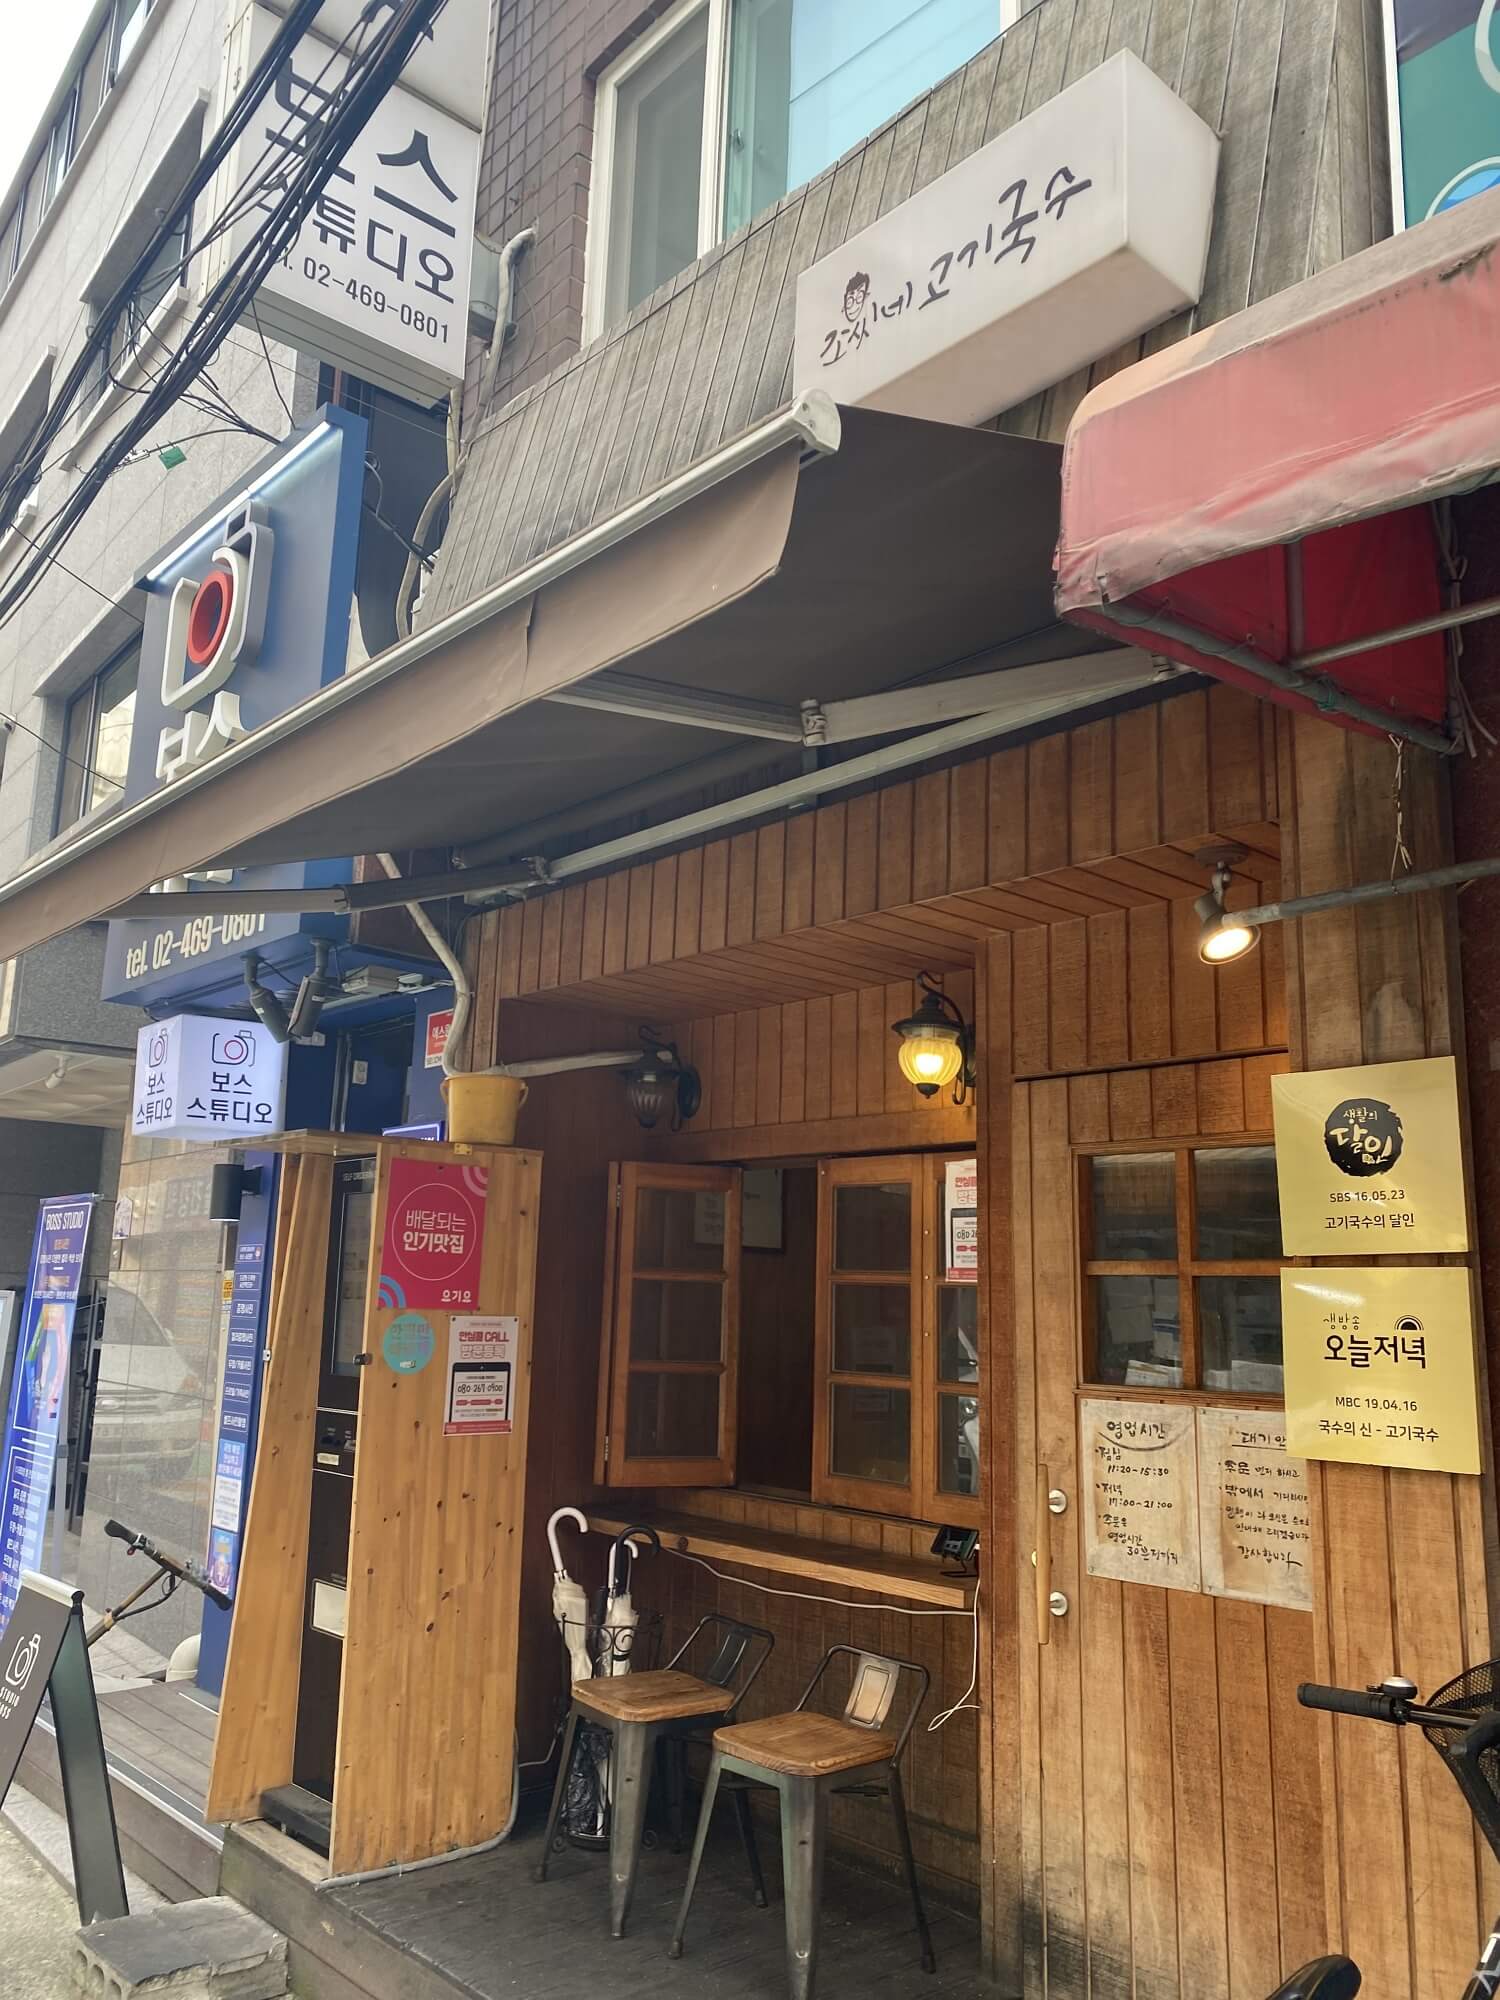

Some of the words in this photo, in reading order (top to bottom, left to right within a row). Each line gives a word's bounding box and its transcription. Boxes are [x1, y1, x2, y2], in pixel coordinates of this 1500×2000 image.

[918, 165, 1092, 310] 고기국수
[303, 257, 449, 344] 02-469-0801
[125, 947, 148, 980] tel.
[147, 1072, 166, 1096] 보스
[210, 1071, 253, 1095] 보스
[136, 1097, 173, 1125] 스튜디오
[186, 1097, 273, 1124] 스튜디오
[1343, 1106, 1378, 1124] 생활의
[1329, 1124, 1393, 1164] 달인
[1329, 1192, 1351, 1203] SBS
[1355, 1189, 1405, 1201] 16.05.23
[405, 1210, 467, 1233] 배달되는
[1325, 1214, 1386, 1230] 고기국수의
[1389, 1212, 1415, 1228] 달인
[403, 1231, 465, 1254] 인기맛집
[1323, 1312, 1361, 1331] 생방송
[484, 1331, 510, 1343] CALL
[1324, 1335, 1427, 1369] 오늘저녁
[1335, 1396, 1361, 1408] MBC
[1364, 1398, 1418, 1412] 19.04.16
[1318, 1419, 1356, 1437] 국수의
[1359, 1422, 1373, 1438] 신
[1385, 1424, 1440, 1443] 고기국수
[1100, 1483, 1123, 1496] 저녁
[1224, 1484, 1264, 1500] 밖에서
[1237, 1546, 1303, 1572] 감사합니다
